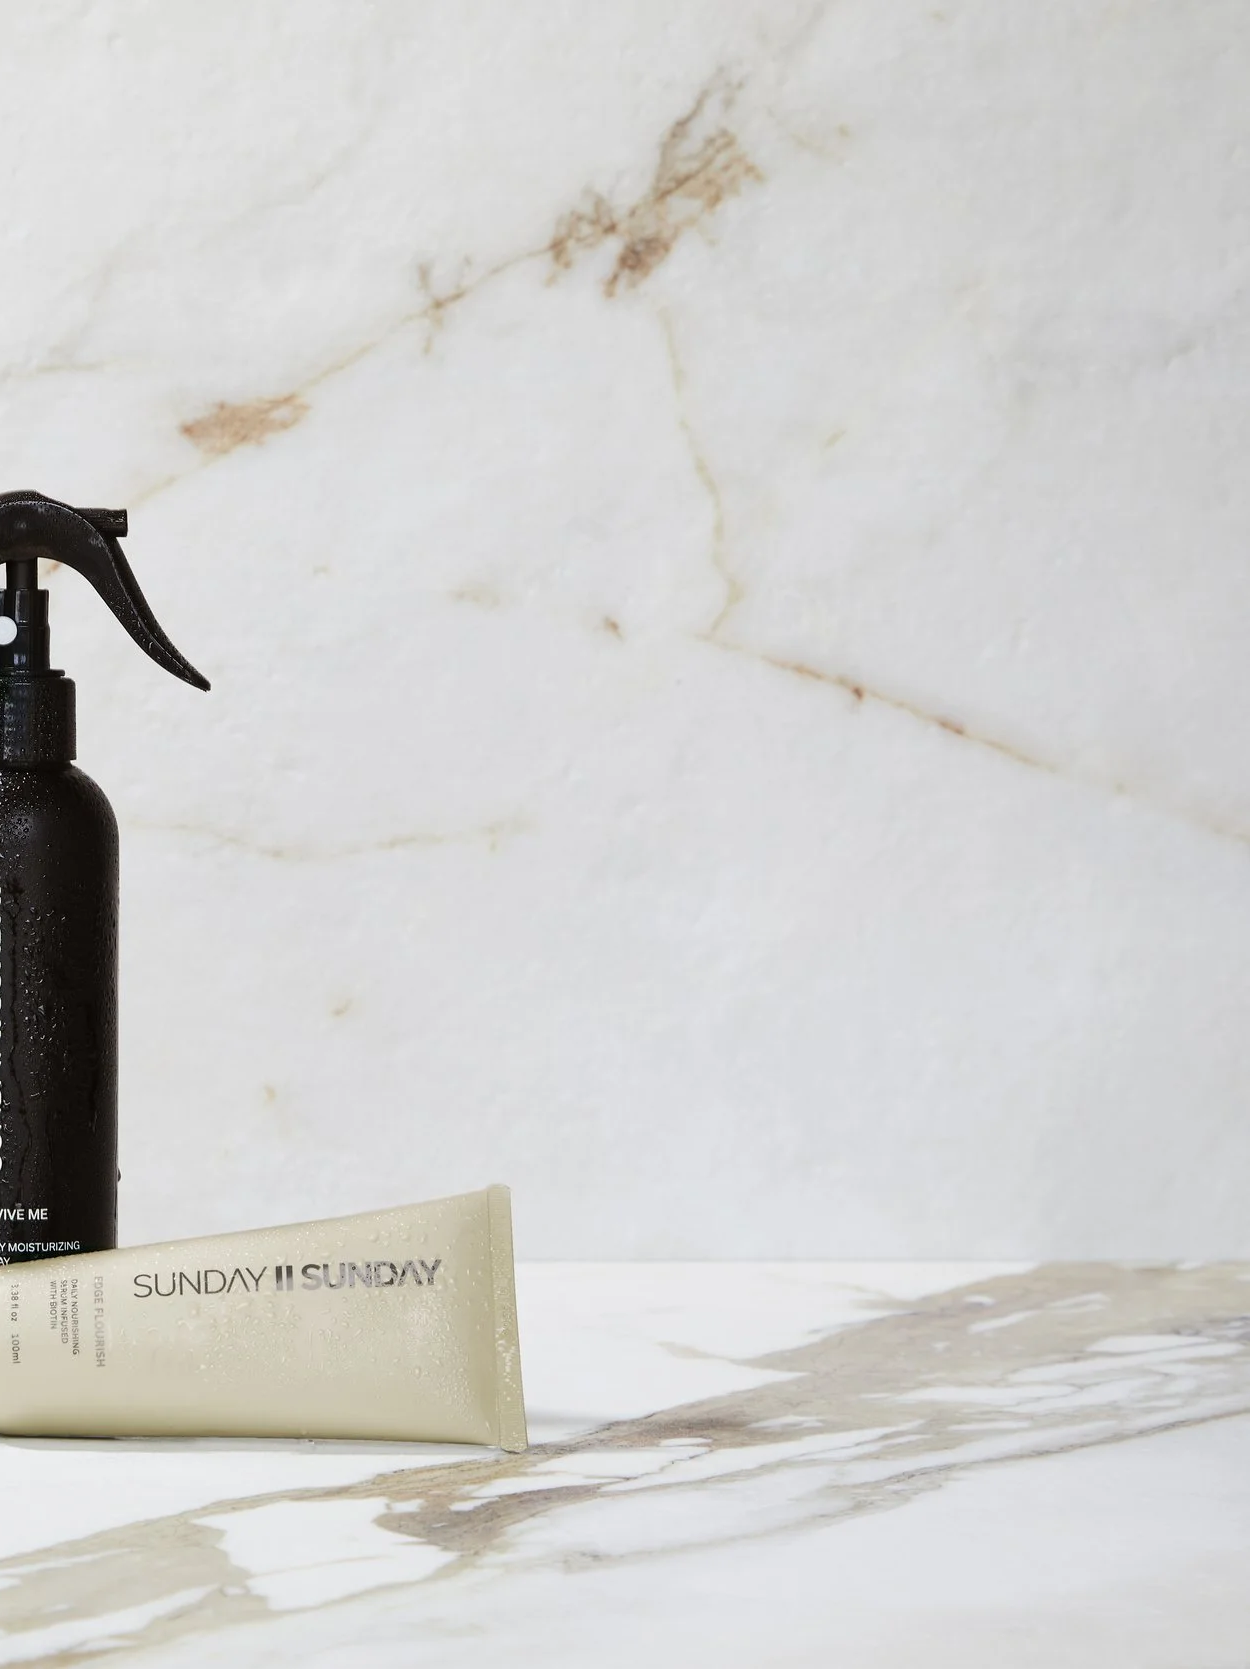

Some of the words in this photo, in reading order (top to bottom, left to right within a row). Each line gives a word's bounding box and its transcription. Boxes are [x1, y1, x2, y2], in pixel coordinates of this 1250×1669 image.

[28, 1208, 48, 1220] ME
[8, 1241, 81, 1253] MOISTURIZING
[60, 1279, 68, 1306] SERUM
[70, 1278, 78, 1301] DAILY
[94, 1276, 104, 1305] EDGE
[133, 1265, 268, 1298] SUNDAY
[301, 1258, 443, 1291] SUNDAY
[11, 1311, 18, 1322] oz
[50, 1301, 58, 1330] BIOTIN
[60, 1307, 69, 1344] INFUSED
[71, 1301, 80, 1356] NOURISHING
[11, 1333, 21, 1364] 100ml
[94, 1308, 106, 1368] FLOURISH
